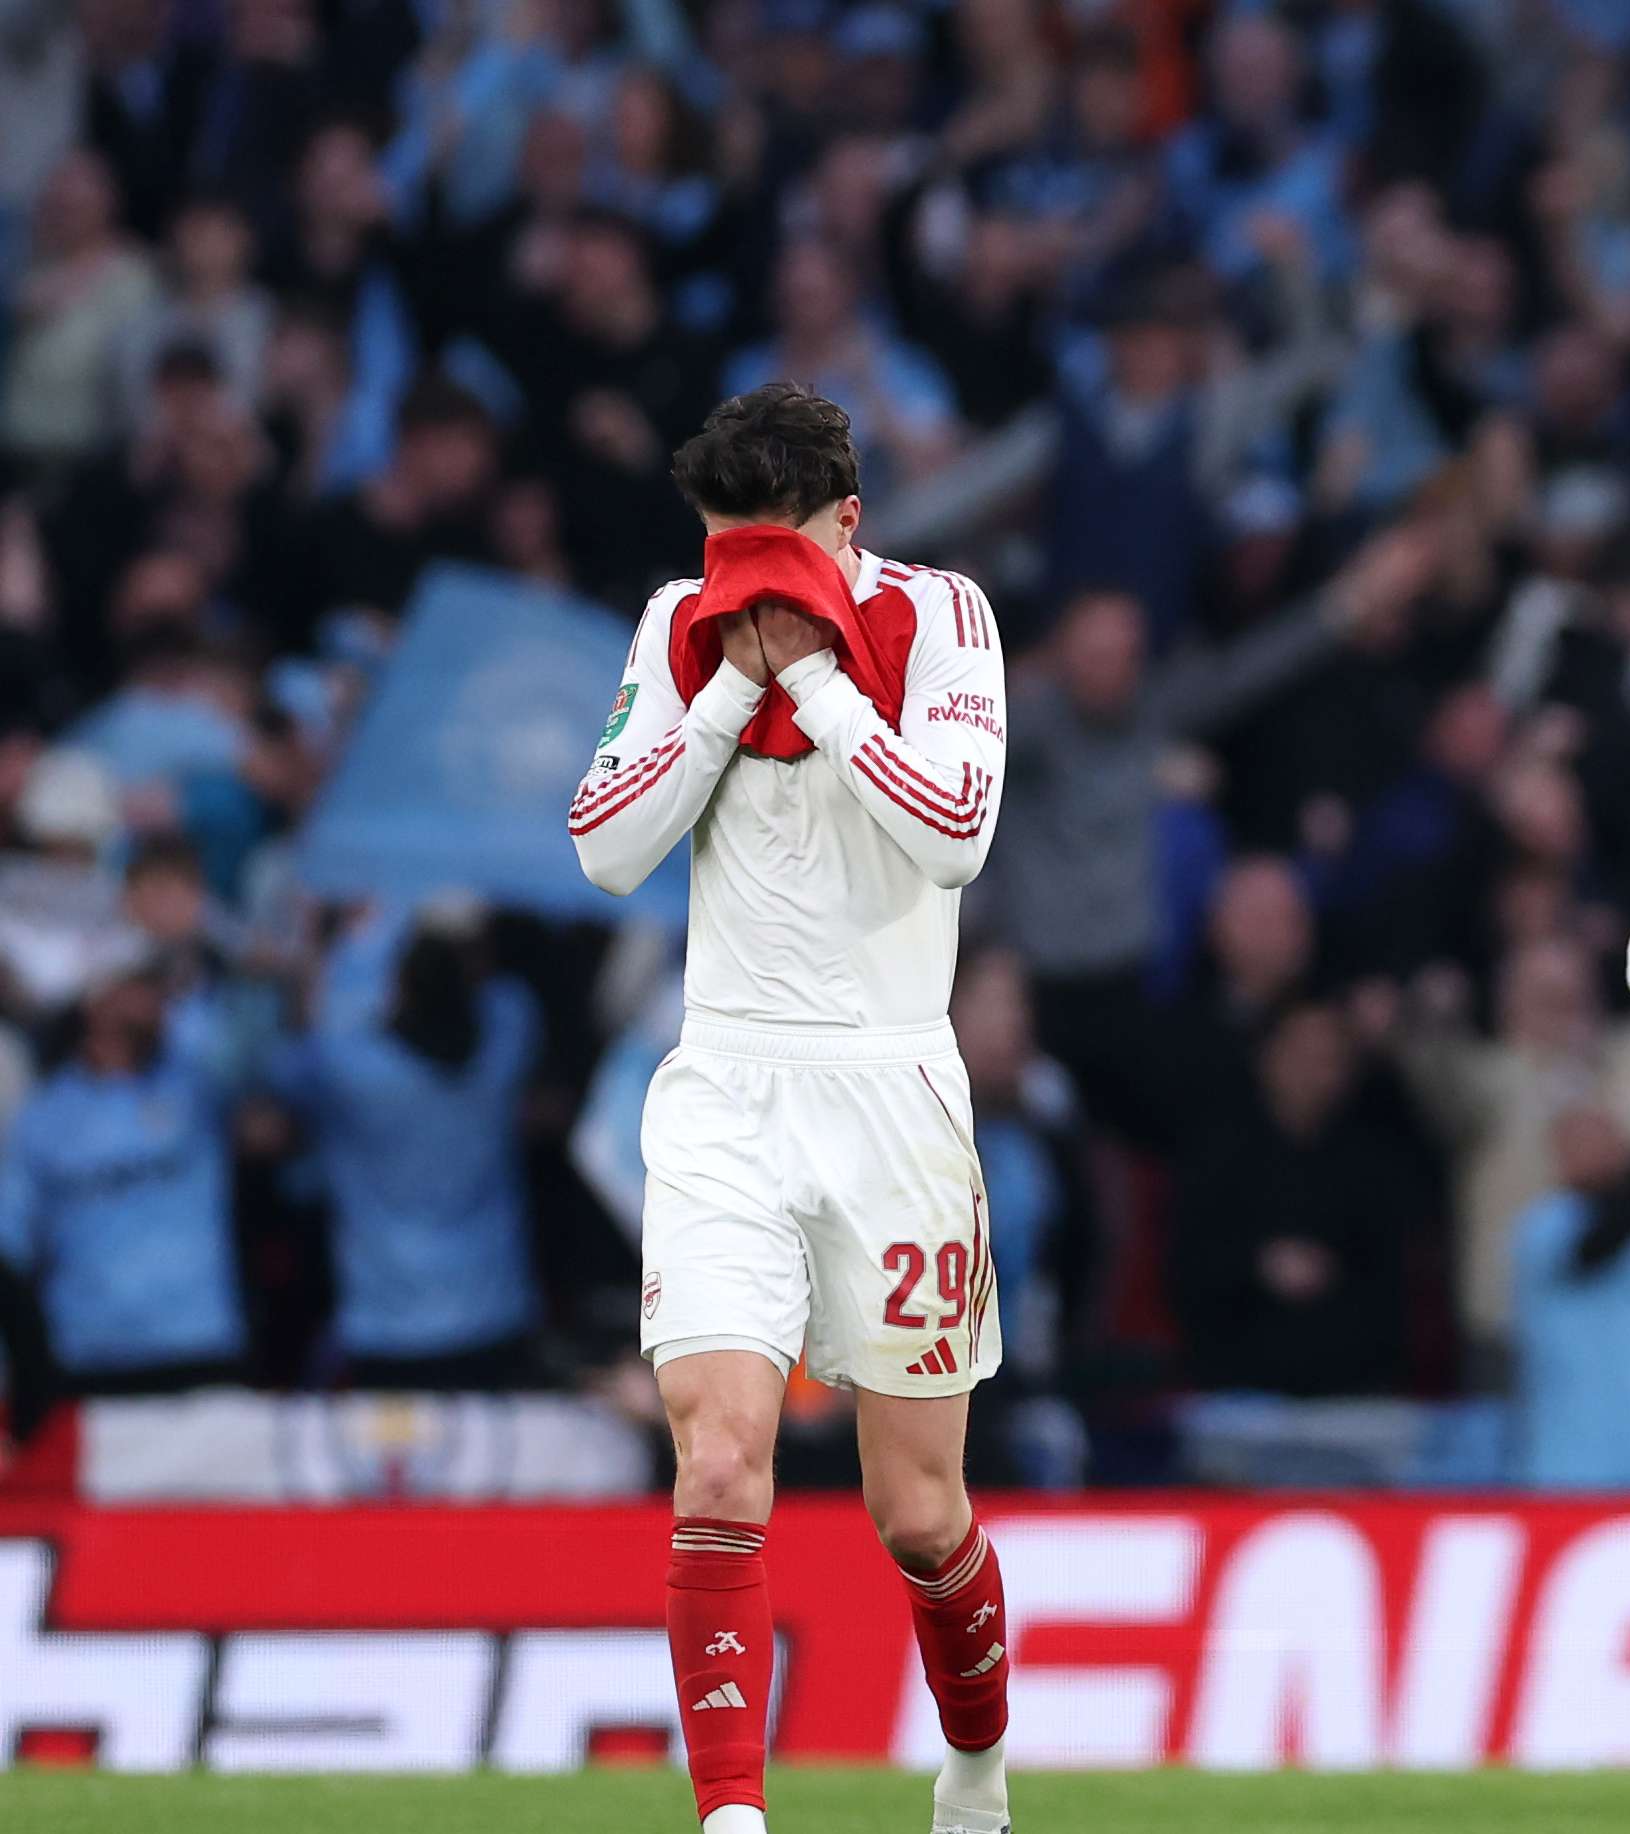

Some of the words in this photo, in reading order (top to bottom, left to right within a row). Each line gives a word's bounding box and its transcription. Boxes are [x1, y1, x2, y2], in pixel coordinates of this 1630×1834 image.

[947, 691, 994, 715] VISIT
[928, 705, 1004, 745] RWANDA
[880, 1240, 969, 1332] 29
